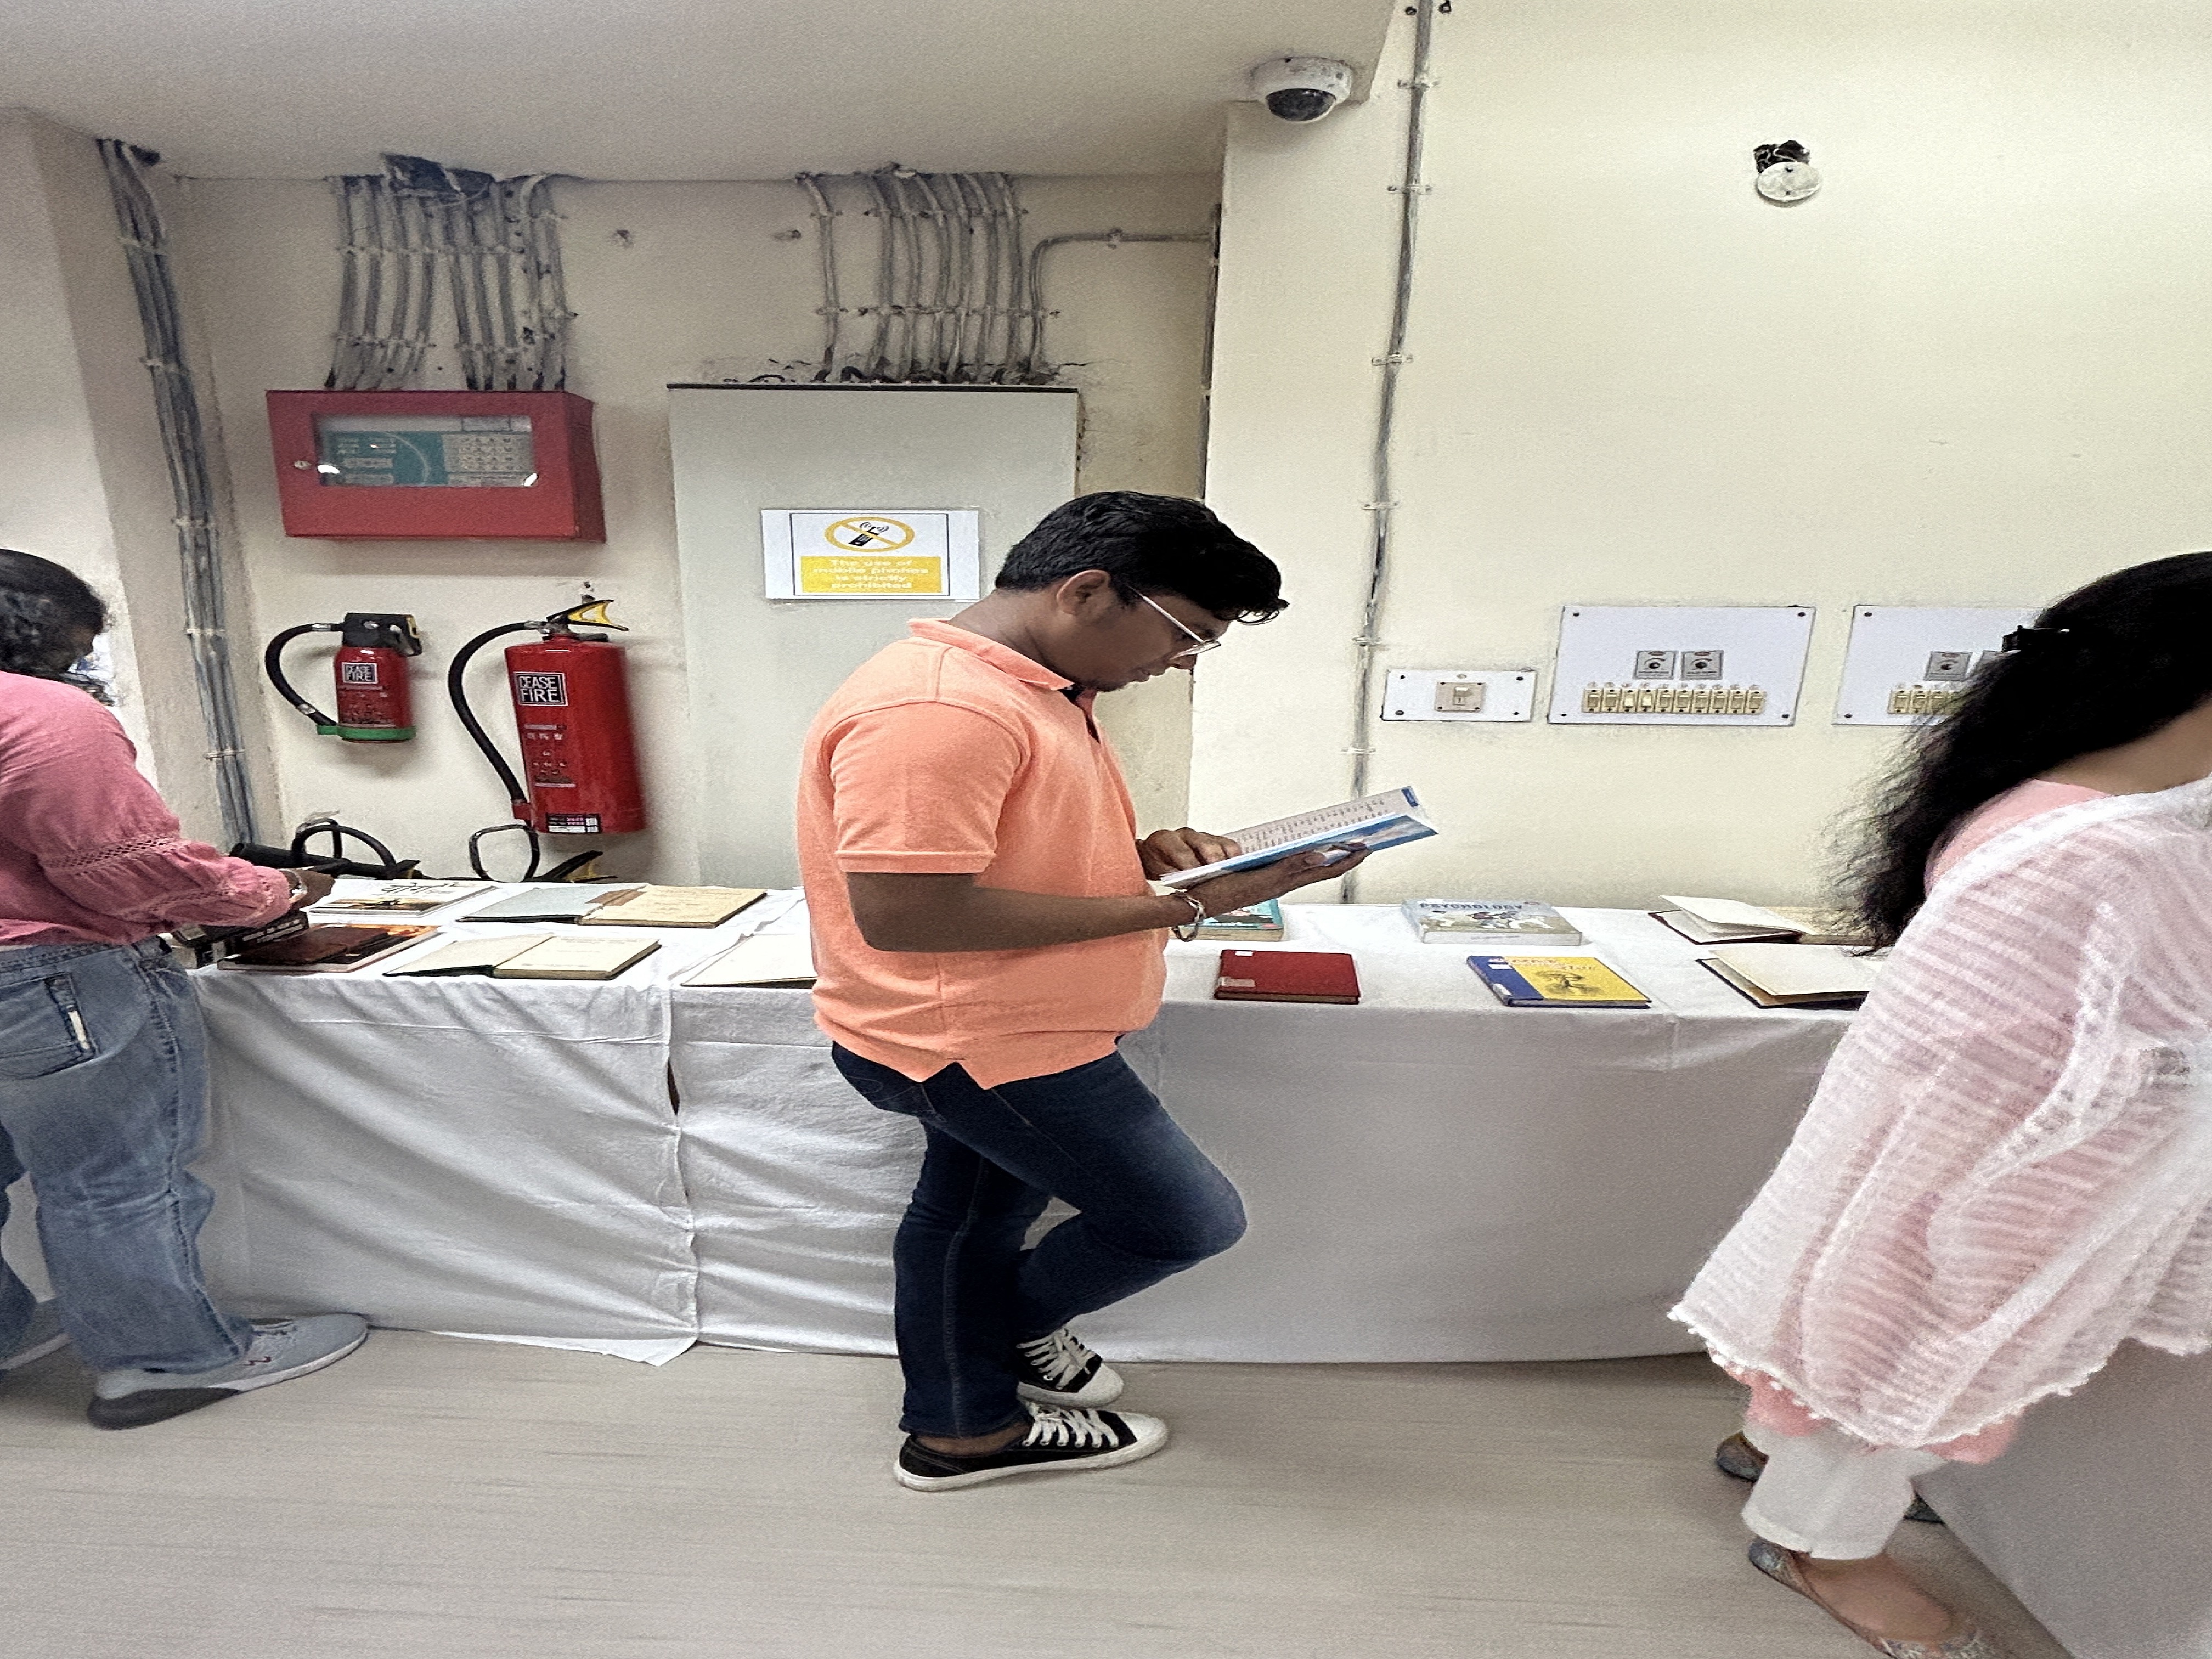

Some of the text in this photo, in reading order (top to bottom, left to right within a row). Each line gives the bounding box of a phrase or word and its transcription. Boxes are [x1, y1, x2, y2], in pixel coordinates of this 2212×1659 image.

[346, 672, 371, 681] FIRE
[519, 676, 557, 689] CEASE
[520, 689, 560, 702] FIRE
